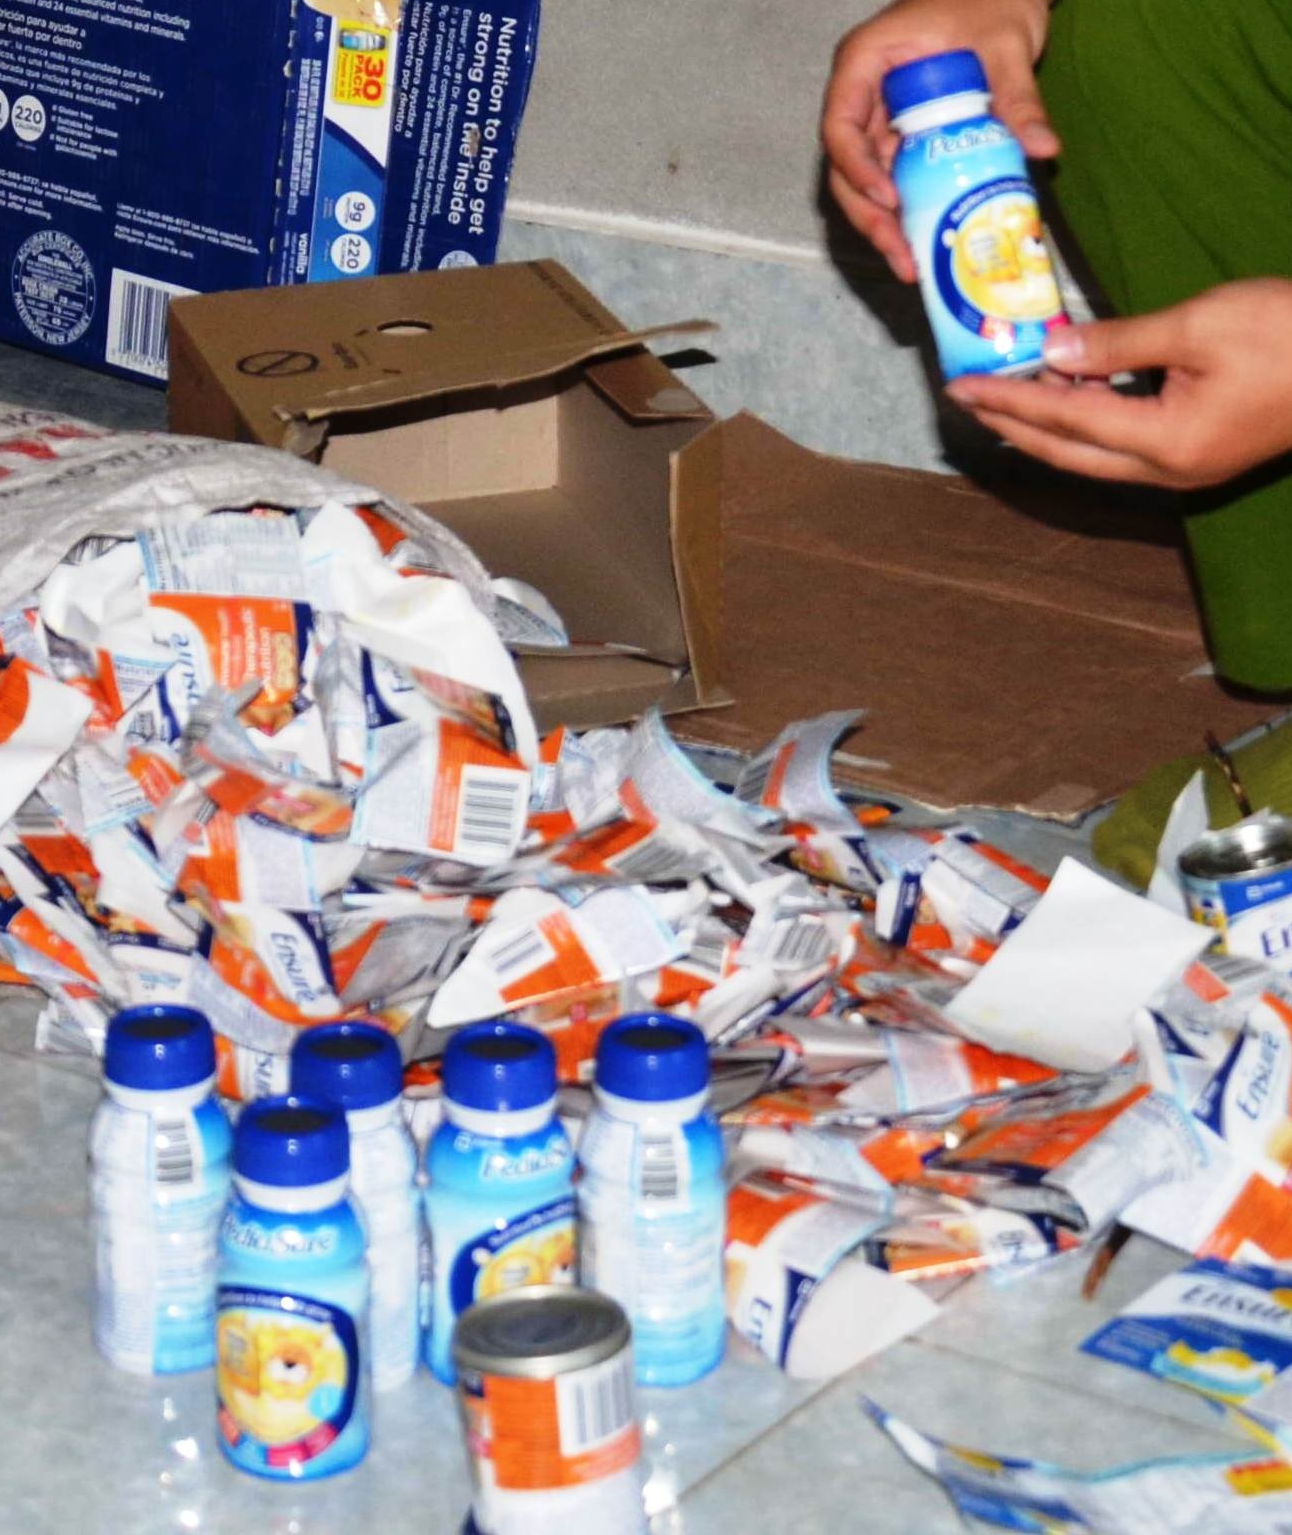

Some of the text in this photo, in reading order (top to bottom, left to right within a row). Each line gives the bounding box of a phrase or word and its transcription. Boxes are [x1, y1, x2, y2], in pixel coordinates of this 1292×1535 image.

[27, 15, 46, 28] para
[49, 20, 76, 35] ayudar
[53, 1, 63, 11] 24
[65, 5, 98, 21] essential
[101, 13, 132, 28] vitamins
[134, 20, 149, 32] and
[118, 3, 151, 19] nutrition
[153, 12, 190, 29] including
[415, 2, 433, 54] Nutrición
[36, 31, 51, 43] por
[53, 34, 82, 50] dentro
[402, 31, 417, 66] fuerte
[464, 12, 491, 84] strong
[351, 54, 366, 97] PACK
[363, 57, 385, 101] 30
[398, 69, 410, 90] por
[408, 58, 424, 85] para
[15, 106, 42, 124] 220
[404, 88, 421, 128] ayudar
[467, 88, 485, 115] on
[467, 17, 517, 235] Nutrition to help get
[447, 162, 474, 225] inside
[296, 233, 309, 274] vanilla
[347, 201, 366, 269] 9g 220
[272, 931, 316, 1004] Ensure
